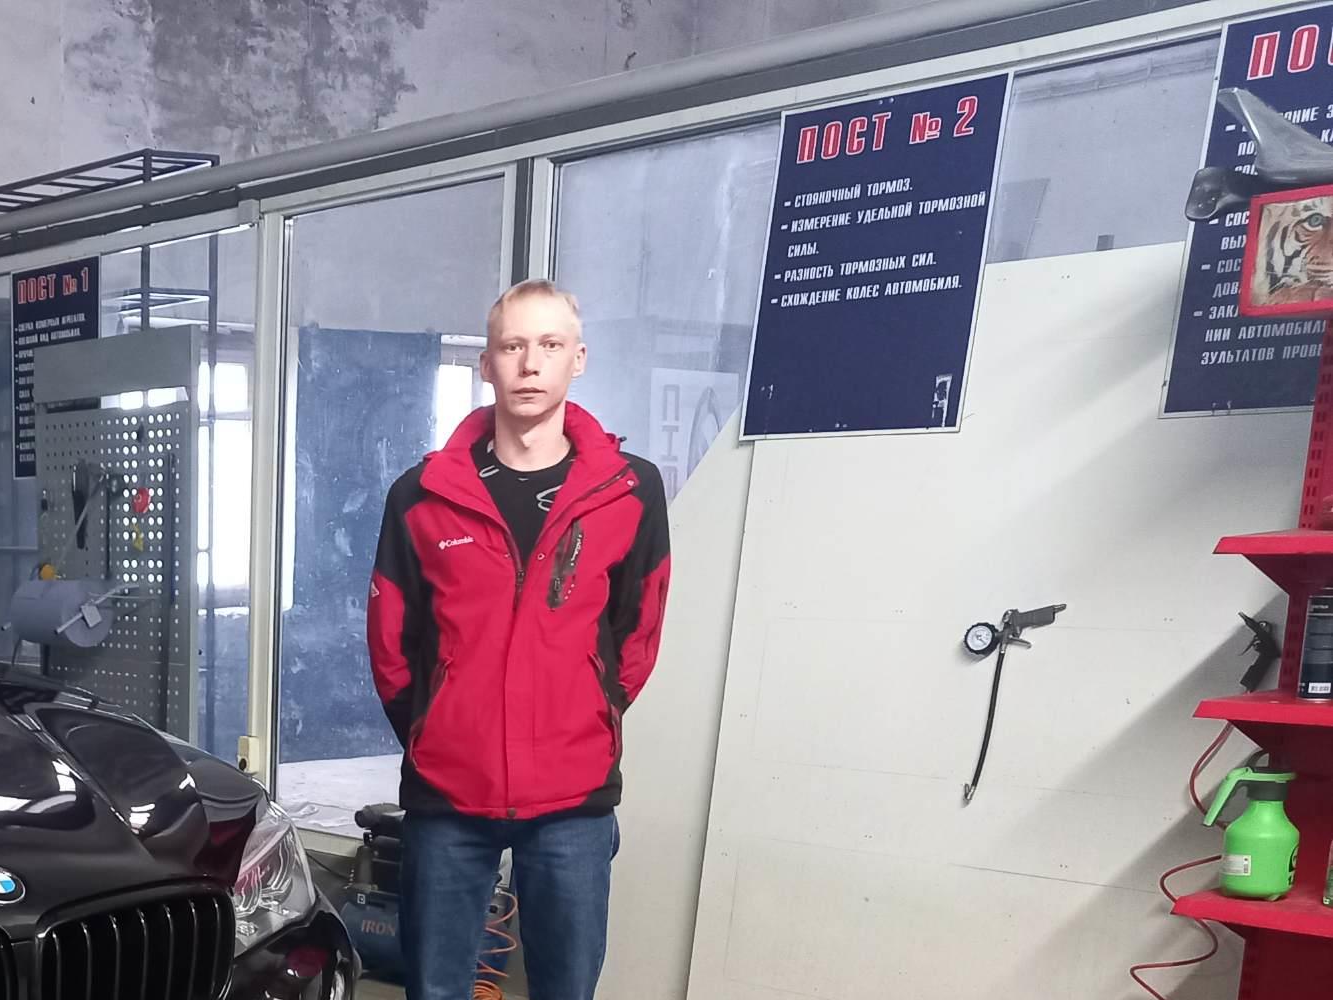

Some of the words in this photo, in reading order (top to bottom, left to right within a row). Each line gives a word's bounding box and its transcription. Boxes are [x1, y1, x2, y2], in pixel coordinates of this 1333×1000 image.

[796, 112, 891, 164] ПОСТ
[909, 112, 942, 144] №
[953, 96, 978, 137] 2
[795, 183, 861, 208] СТОЯНОЧНЫЙ
[867, 177, 913, 197] ТОРМОЗ.
[790, 212, 851, 232] ИЗМЕРЕНИЕ
[856, 201, 912, 224] УДЕЛЬНОЙ
[919, 191, 986, 215] ТОРМОЗНОЙ
[787, 242, 819, 258] СИЛЫ.
[784, 265, 834, 282] РАЗНОСТЬ
[840, 256, 906, 276] ТОРМОЗНЫХ
[912, 252, 937, 267] СИЛ.
[18, 273, 56, 304] ПОСТ
[81, 267, 89, 292] 1
[781, 288, 841, 307] СХОЖДЕНИЕ
[846, 285, 879, 300] КОЛЕС
[884, 275, 962, 296] АВТОМОБИЛЯ.
[1201, 347, 1275, 365] ЗУЛЬТАТОВ
